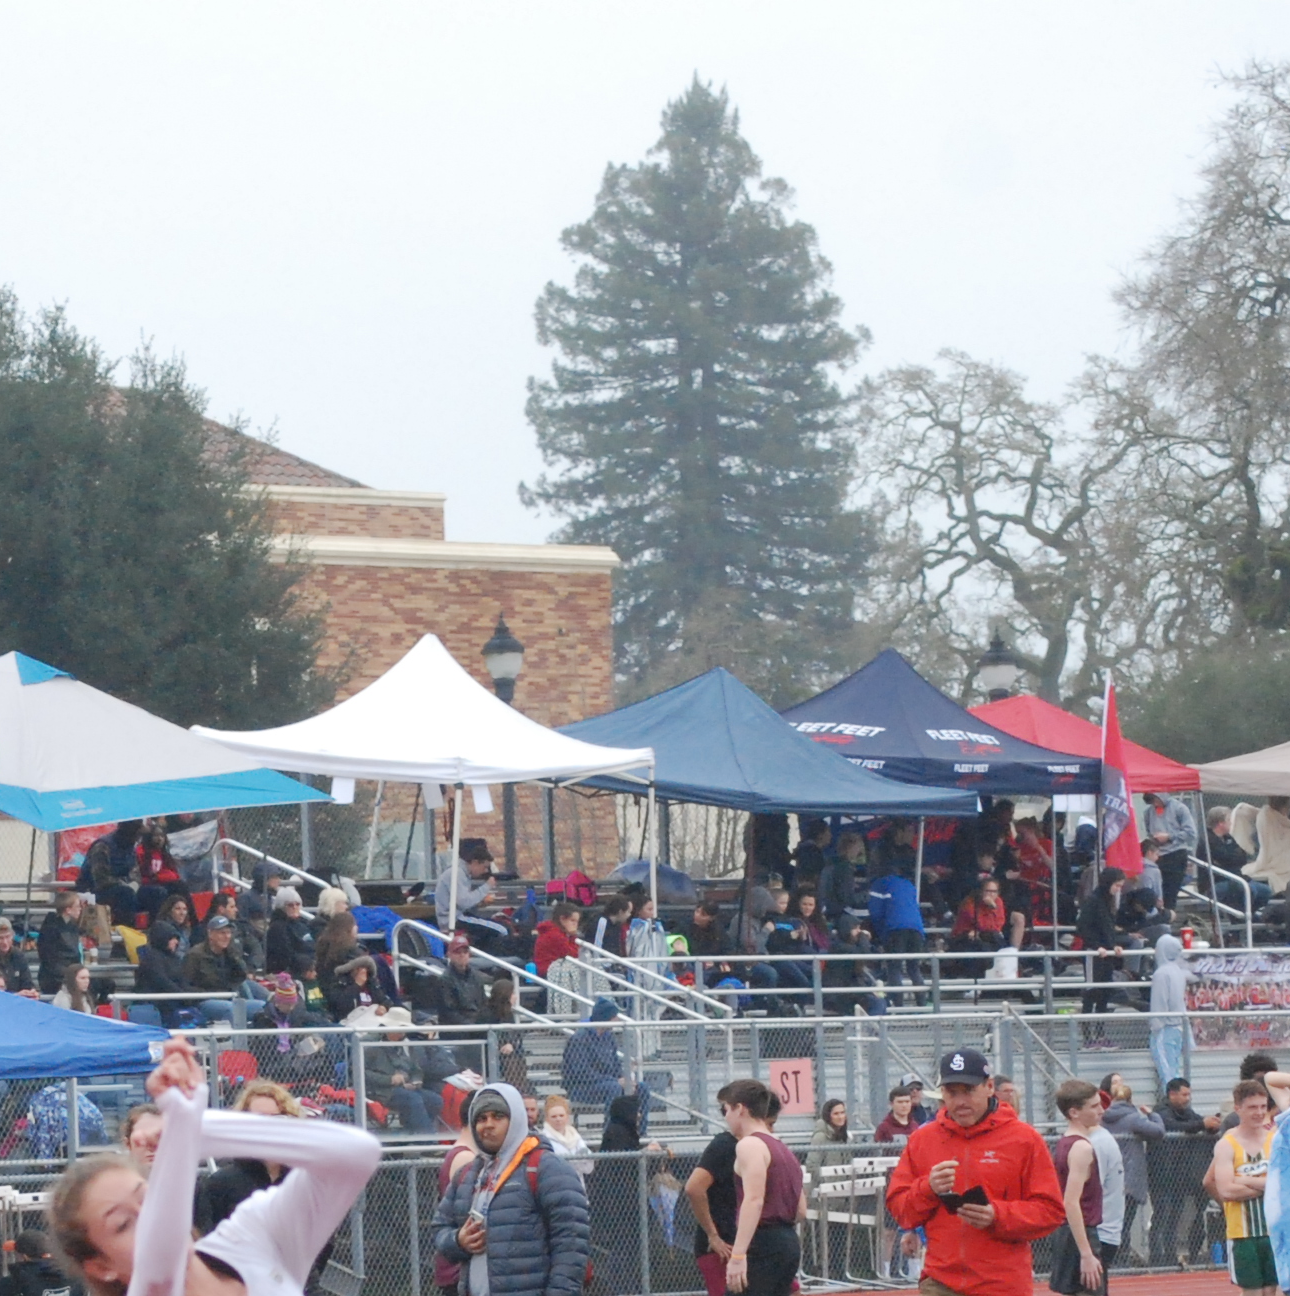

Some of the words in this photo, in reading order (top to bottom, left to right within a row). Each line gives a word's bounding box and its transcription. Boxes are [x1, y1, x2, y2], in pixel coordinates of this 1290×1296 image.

[832, 723, 886, 737] FEET
[925, 729, 971, 741] FLEET
[967, 731, 1000, 745] FEET
[862, 759, 886, 769] FEET
[780, 1070, 801, 1105] ST
